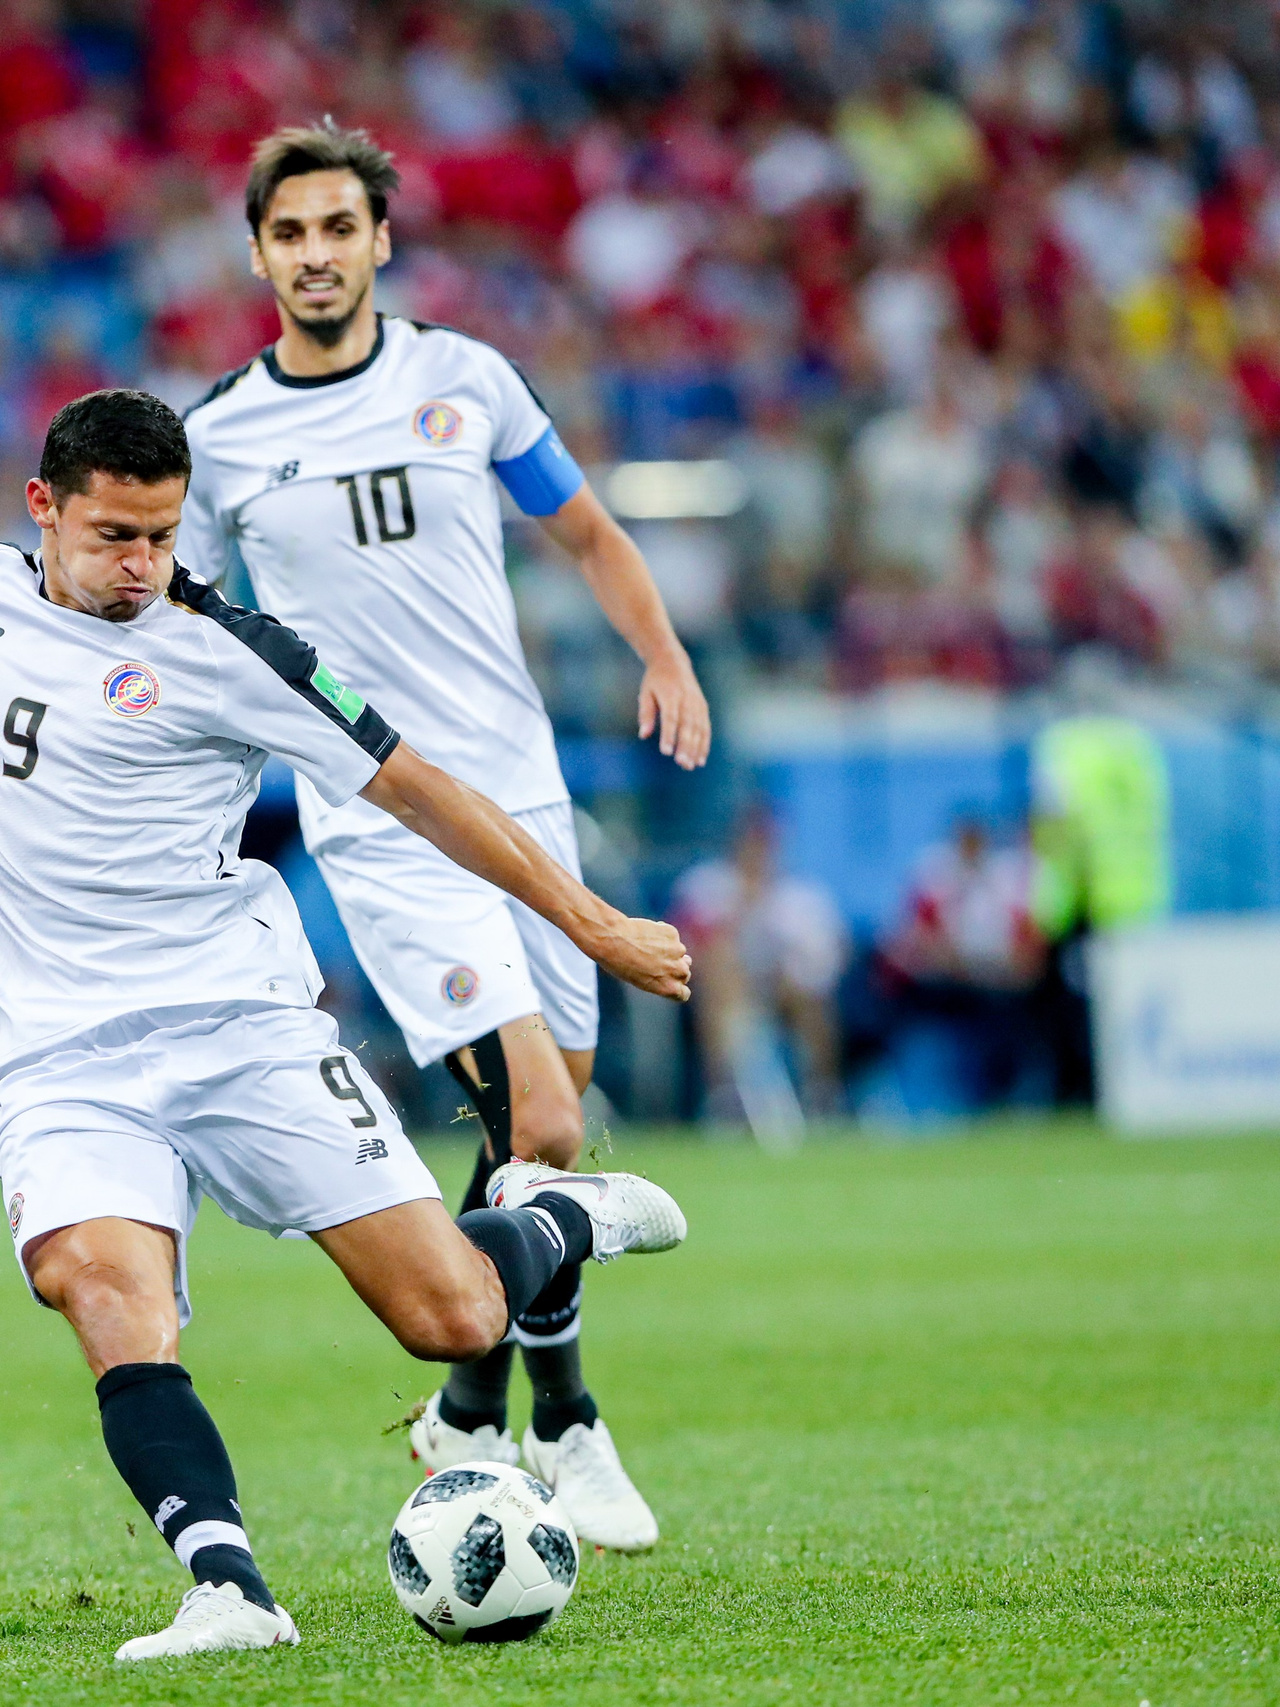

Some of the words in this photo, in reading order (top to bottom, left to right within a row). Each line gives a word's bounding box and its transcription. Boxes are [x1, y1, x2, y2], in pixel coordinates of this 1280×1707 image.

[335, 466, 416, 546] 10
[2, 696, 50, 781] 9
[319, 1055, 378, 1129] 9
